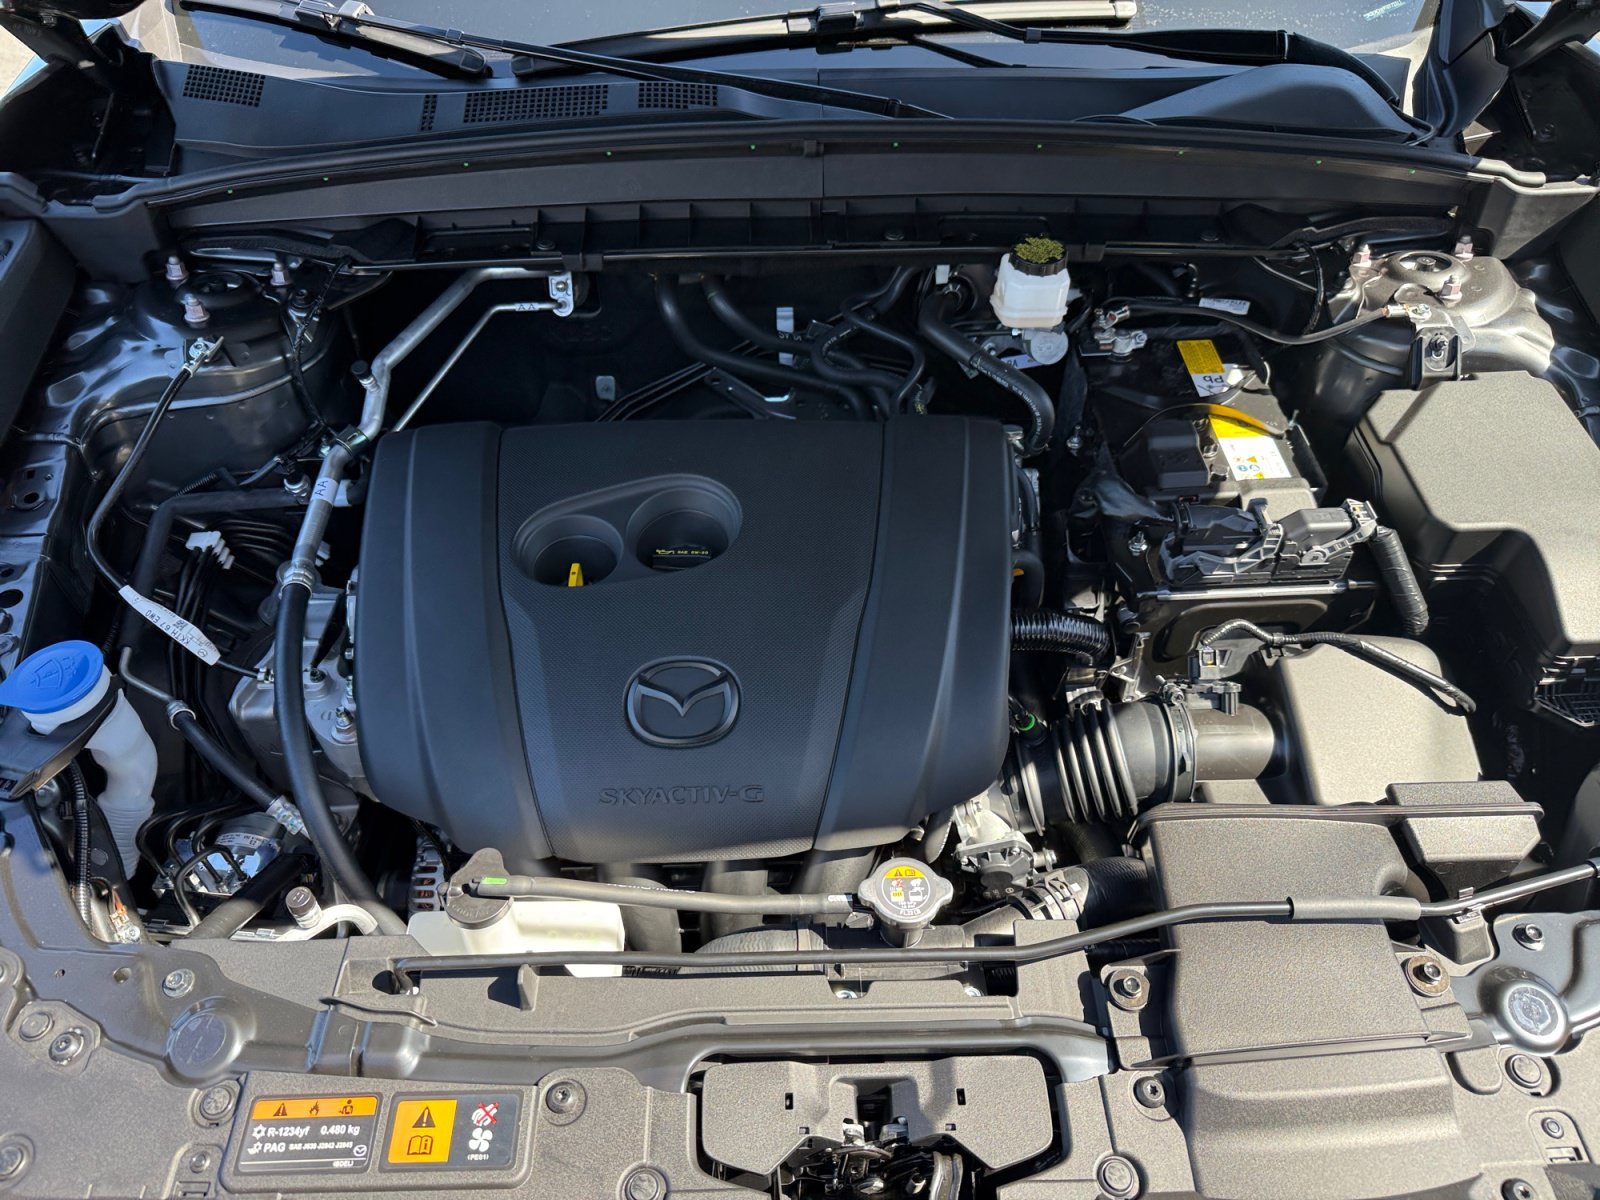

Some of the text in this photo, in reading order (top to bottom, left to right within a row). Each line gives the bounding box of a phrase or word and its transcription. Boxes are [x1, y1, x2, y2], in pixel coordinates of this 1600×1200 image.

[599, 784, 764, 806] SKYACTIV-G
[266, 1124, 361, 1138] R-1234yf 0.480 kg
[263, 1142, 286, 1153] PAG
